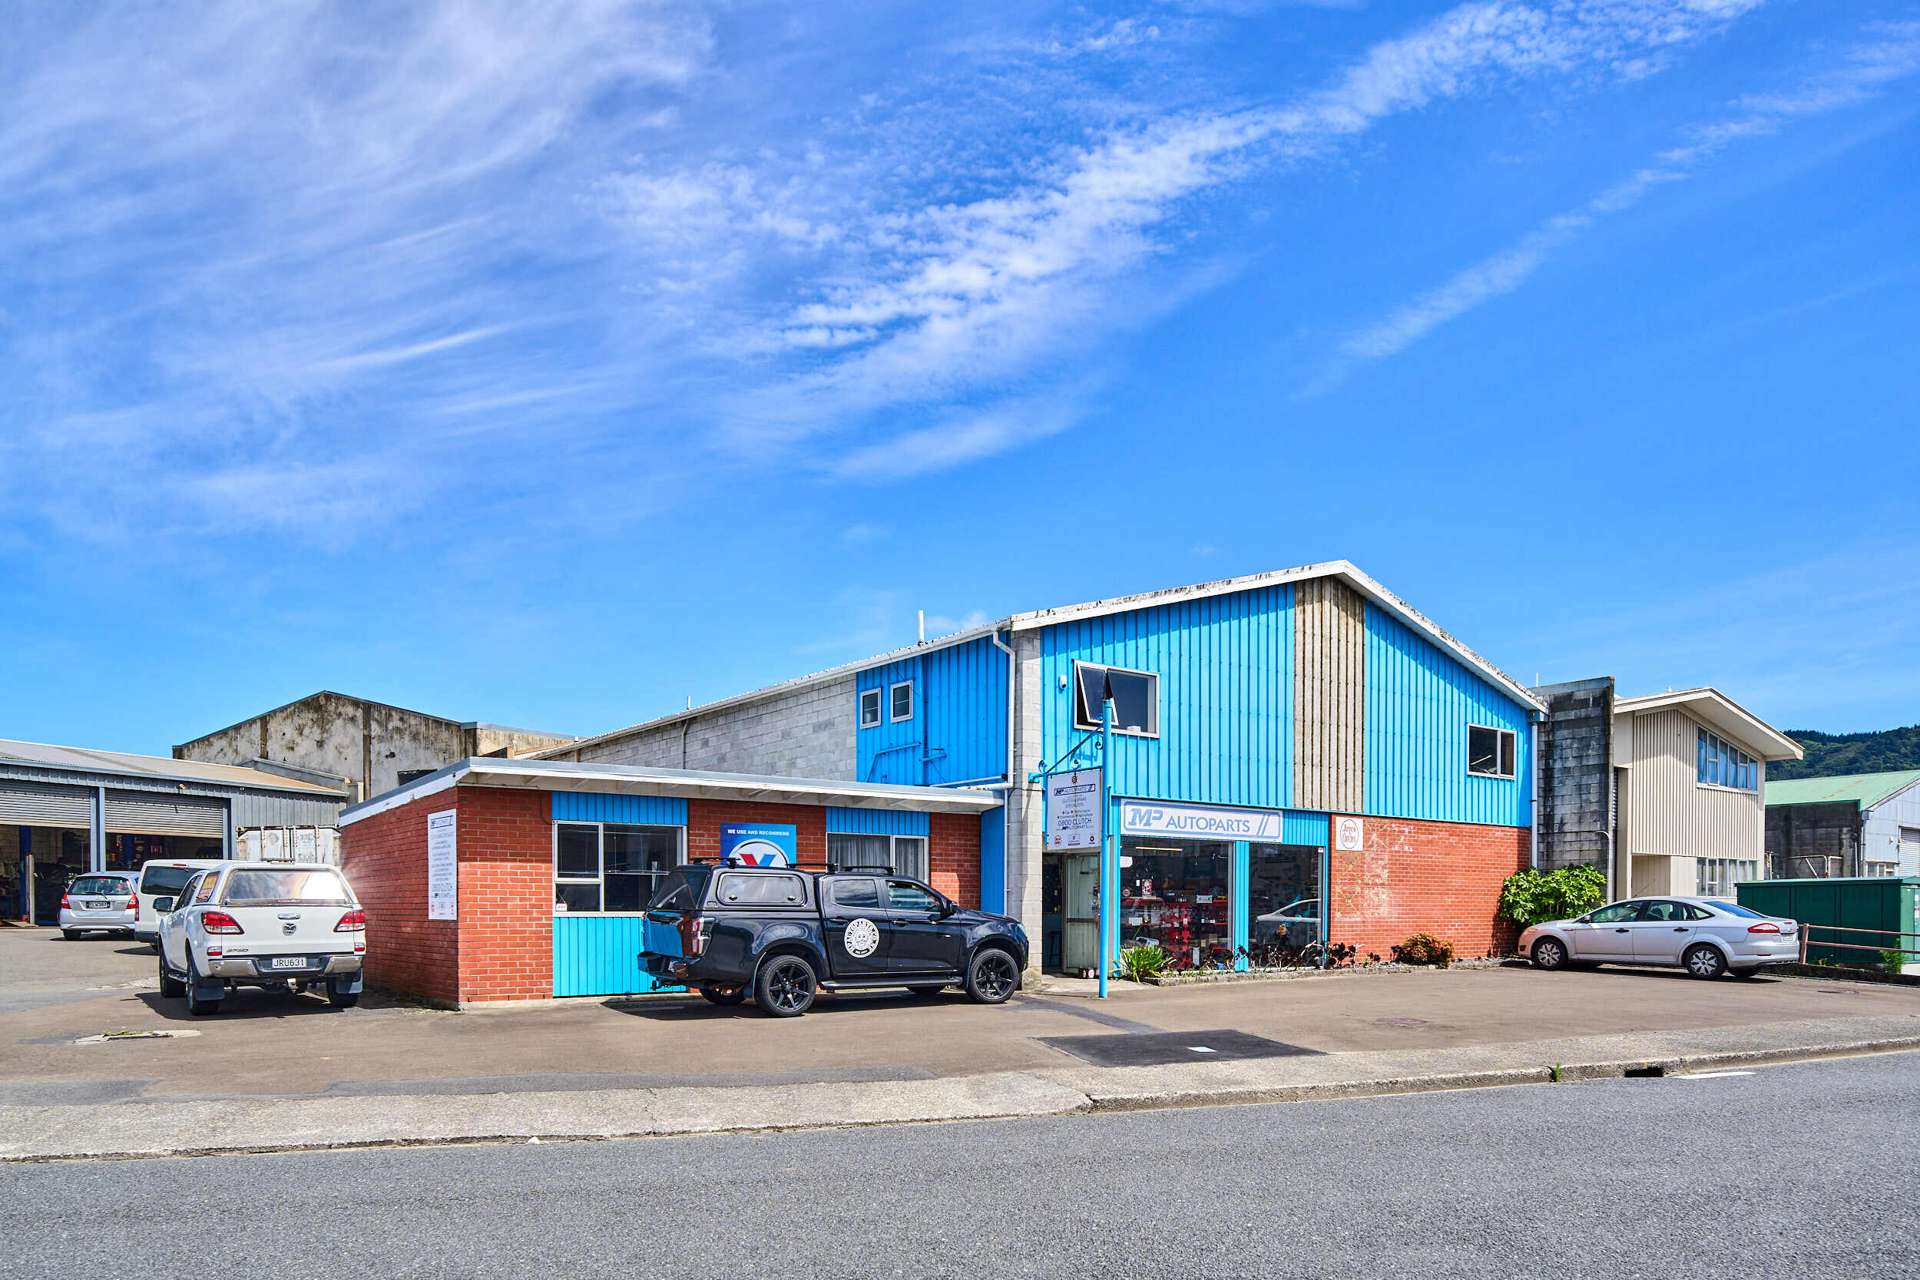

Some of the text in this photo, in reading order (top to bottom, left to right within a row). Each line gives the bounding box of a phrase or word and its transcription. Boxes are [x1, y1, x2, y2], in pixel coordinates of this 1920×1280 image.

[1072, 817, 1091, 826] CLUTCH
[1128, 808, 1251, 833] MP AUTOPARTS
[273, 959, 304, 967] JRU631
